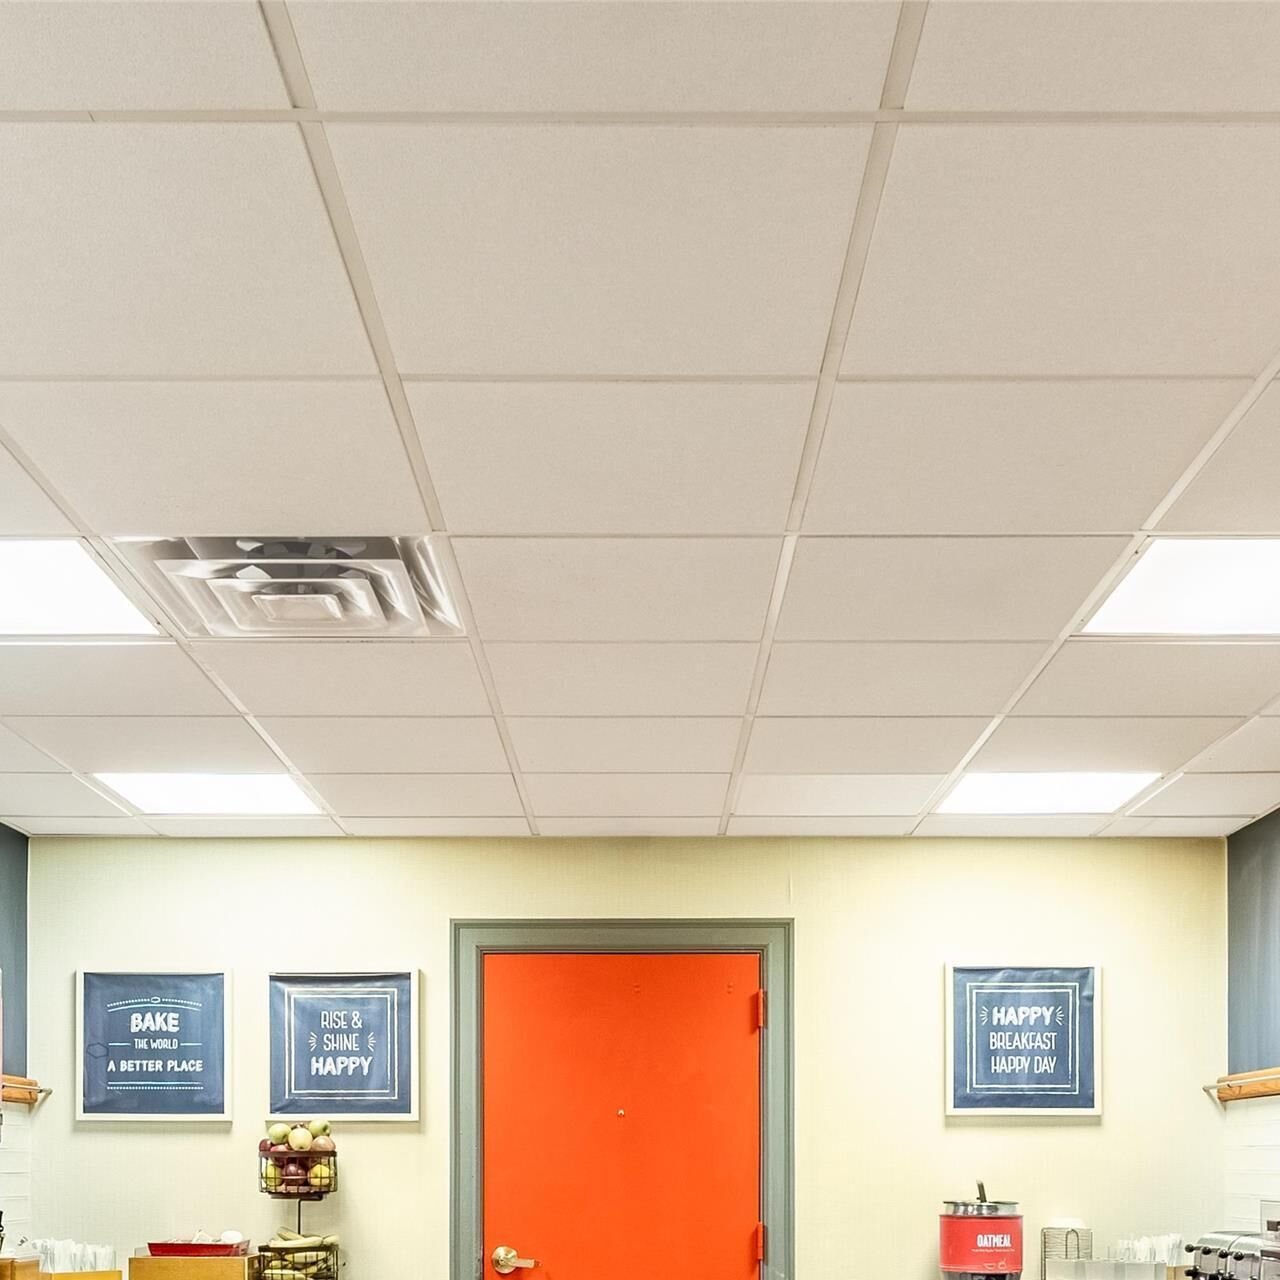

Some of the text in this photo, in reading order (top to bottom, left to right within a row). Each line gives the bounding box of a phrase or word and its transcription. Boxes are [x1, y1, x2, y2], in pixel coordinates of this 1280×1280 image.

[130, 1011, 180, 1033] BAKE
[321, 1011, 362, 1029] RISE &
[992, 1006, 1055, 1026] HAPPY
[134, 1039, 178, 1050] THE WORLD
[323, 1033, 360, 1051] SHINE
[989, 1032, 1057, 1050] BREAKFAST
[107, 1060, 203, 1072] A BETTER PLACE
[310, 1056, 373, 1076] HAPPY
[991, 1056, 1056, 1074] HAPPY DAY
[976, 1233, 1012, 1248] OATMEAL
